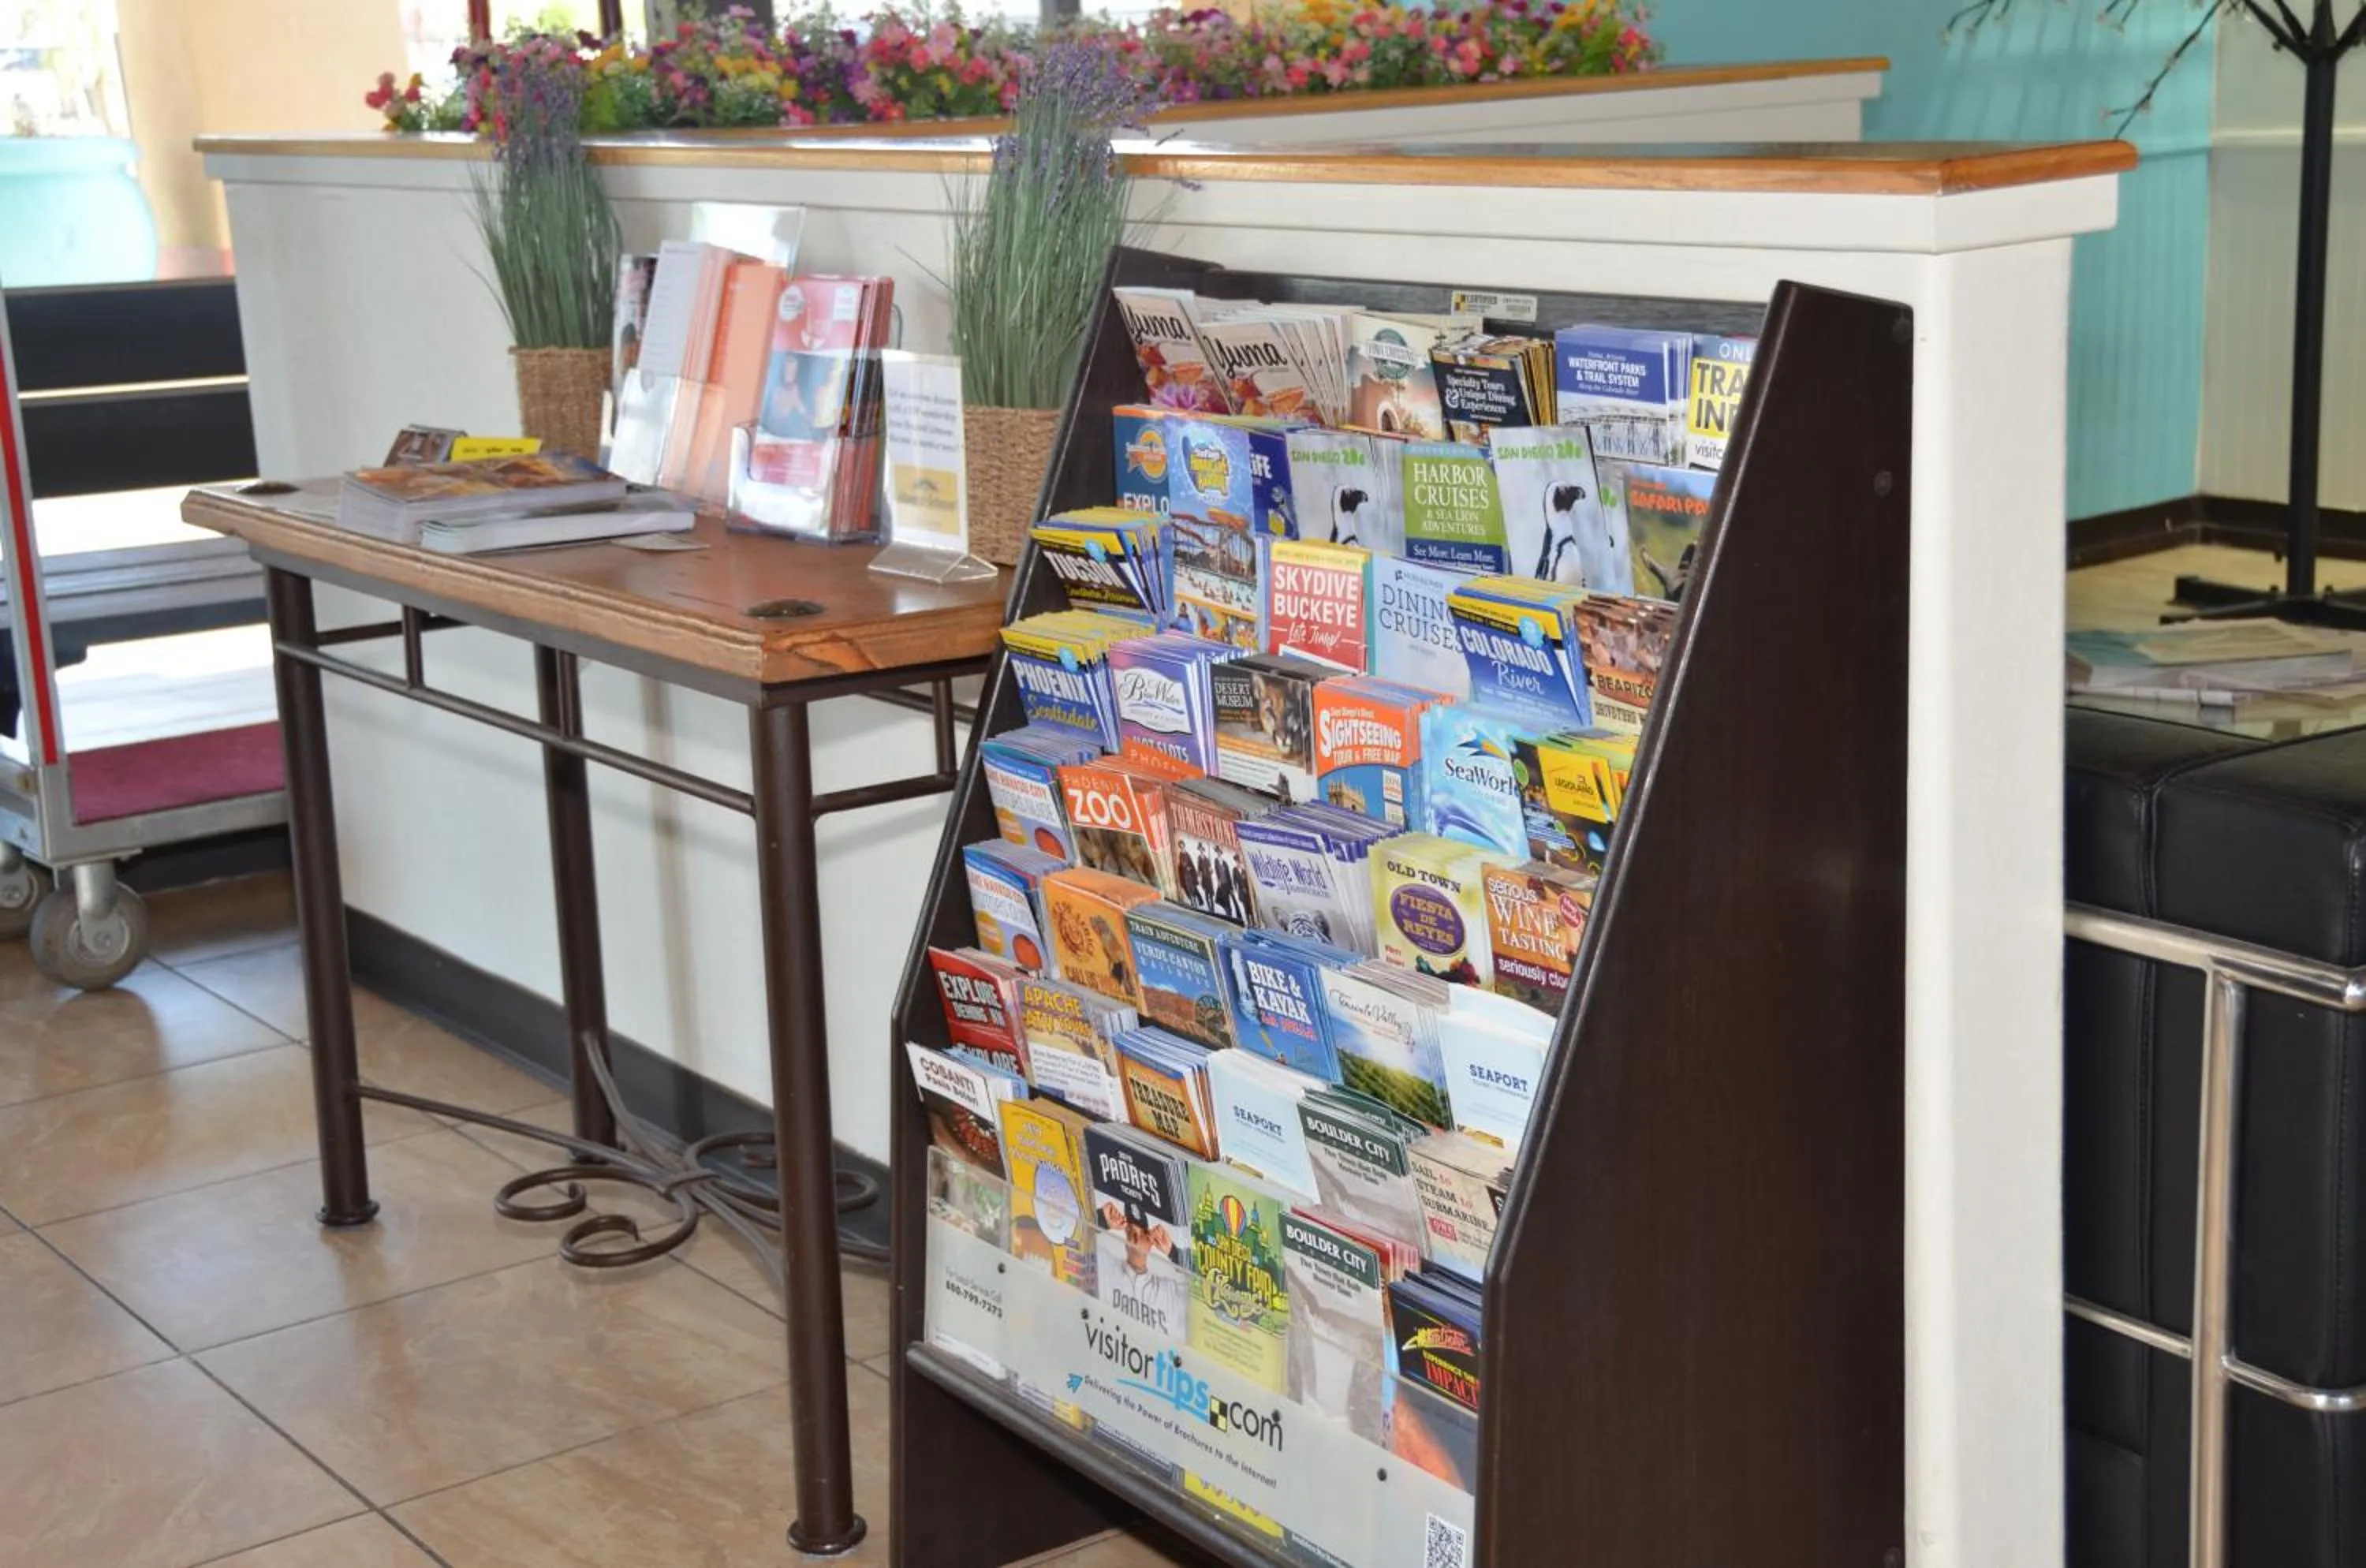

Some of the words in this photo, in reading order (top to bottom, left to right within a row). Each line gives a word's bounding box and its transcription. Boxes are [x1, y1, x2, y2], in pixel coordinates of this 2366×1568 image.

[1119, 301, 1192, 344] Yuma
[1204, 334, 1288, 377] Yuma
[1568, 356, 1620, 372] WATERFRONT
[1621, 361, 1646, 376] PARKS
[1719, 342, 1752, 360] ONL
[1446, 374, 1480, 390] Specialty
[1481, 378, 1505, 391] Tours
[1584, 371, 1607, 384] TRAIL
[1608, 374, 1640, 387] SYSTEM
[1696, 361, 1746, 397] TRA
[1459, 387, 1487, 402] Unique
[1488, 390, 1516, 407] Dining
[1460, 398, 1506, 414] Experiences
[1413, 462, 1487, 487] HARBOR
[1123, 492, 1170, 515] EXPLO
[1413, 484, 1490, 510] CRUISES
[1629, 489, 1682, 513] SAFARI
[1422, 521, 1486, 536] ADVENTURES
[1413, 544, 1427, 556] See
[1450, 548, 1472, 560] Learn
[1042, 550, 1127, 589] TUCSON
[1274, 564, 1359, 602] SKYDIVE
[1274, 592, 1357, 629] BUCKEYE
[1460, 625, 1554, 677] COLORADO
[1010, 658, 1092, 705] PHOENIX
[1214, 681, 1250, 696] DESERT
[1491, 659, 1546, 696] River
[1596, 673, 1654, 699] BEARIZO
[1216, 694, 1253, 707] MUSEUM
[1319, 708, 1401, 758] SIGHTSEEING
[1333, 749, 1353, 767] TOUR
[1362, 747, 1381, 762] FREE
[1067, 788, 1132, 829] ZOO
[1386, 860, 1416, 878] OLD
[1417, 870, 1461, 893] TOWN
[1488, 876, 1537, 902] serious
[1399, 893, 1454, 923] FIESTA
[1419, 914, 1438, 926] DE
[1489, 893, 1560, 939] WINE
[1402, 918, 1455, 946] REYES
[1498, 926, 1568, 962] TASTING
[1167, 950, 1207, 977] CANYON
[1246, 959, 1289, 995] BIKE
[1288, 975, 1304, 999] &
[1498, 958, 1547, 986] seriously
[1024, 985, 1084, 1018] APACHE
[1253, 984, 1313, 1025] KAYAK
[1468, 1063, 1528, 1092] SEAPORT
[1233, 1104, 1282, 1137] SEAPORT
[1305, 1115, 1364, 1150] BOULDER
[1364, 1141, 1390, 1162] CITY
[1099, 1152, 1162, 1209] PADRES
[1420, 1194, 1489, 1230] SUBMARINE
[1196, 1239, 1245, 1286] COUNTY
[1286, 1223, 1342, 1260] BOULDER
[1342, 1249, 1368, 1274] CITY
[1084, 1375, 1122, 1405] Delivering
[1123, 1395, 1136, 1410] the
[1137, 1404, 1162, 1424] Power
[1163, 1418, 1174, 1430] of
[1174, 1424, 1213, 1454] Brochures
[1226, 1452, 1239, 1467] the
